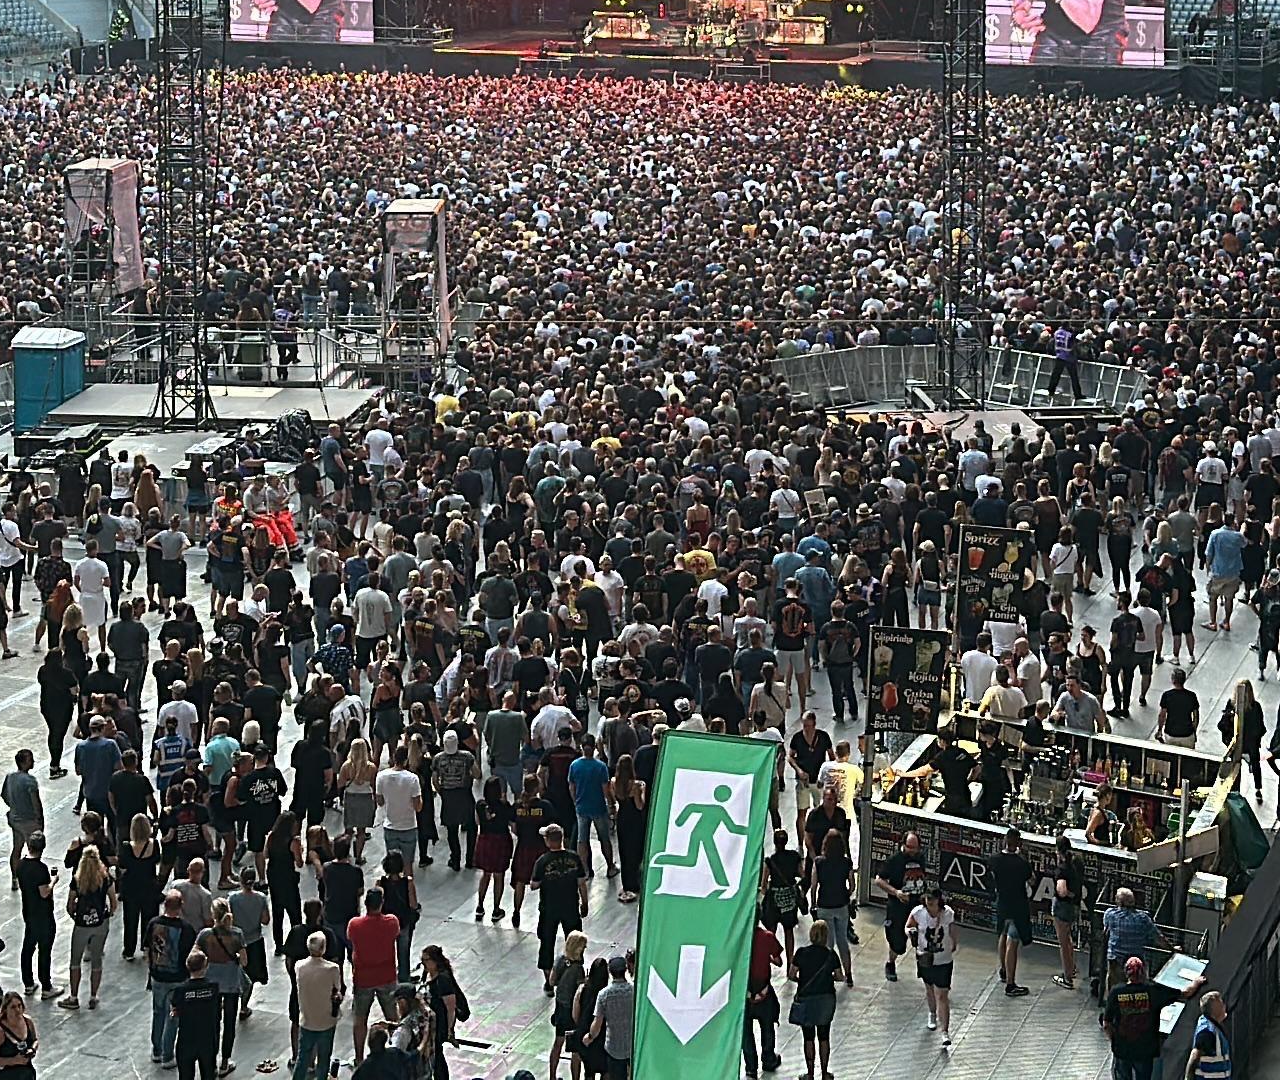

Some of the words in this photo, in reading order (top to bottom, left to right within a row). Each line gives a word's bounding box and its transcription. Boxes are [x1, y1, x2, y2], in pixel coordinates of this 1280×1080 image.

[964, 531, 1000, 546] Sprizz
[989, 567, 1020, 583] Hugos
[988, 608, 1017, 621] Tonic
[1000, 603, 1017, 613] Gin
[908, 671, 939, 684] Mojito
[904, 688, 934, 699] Cuba
[872, 720, 900, 730] Beach
